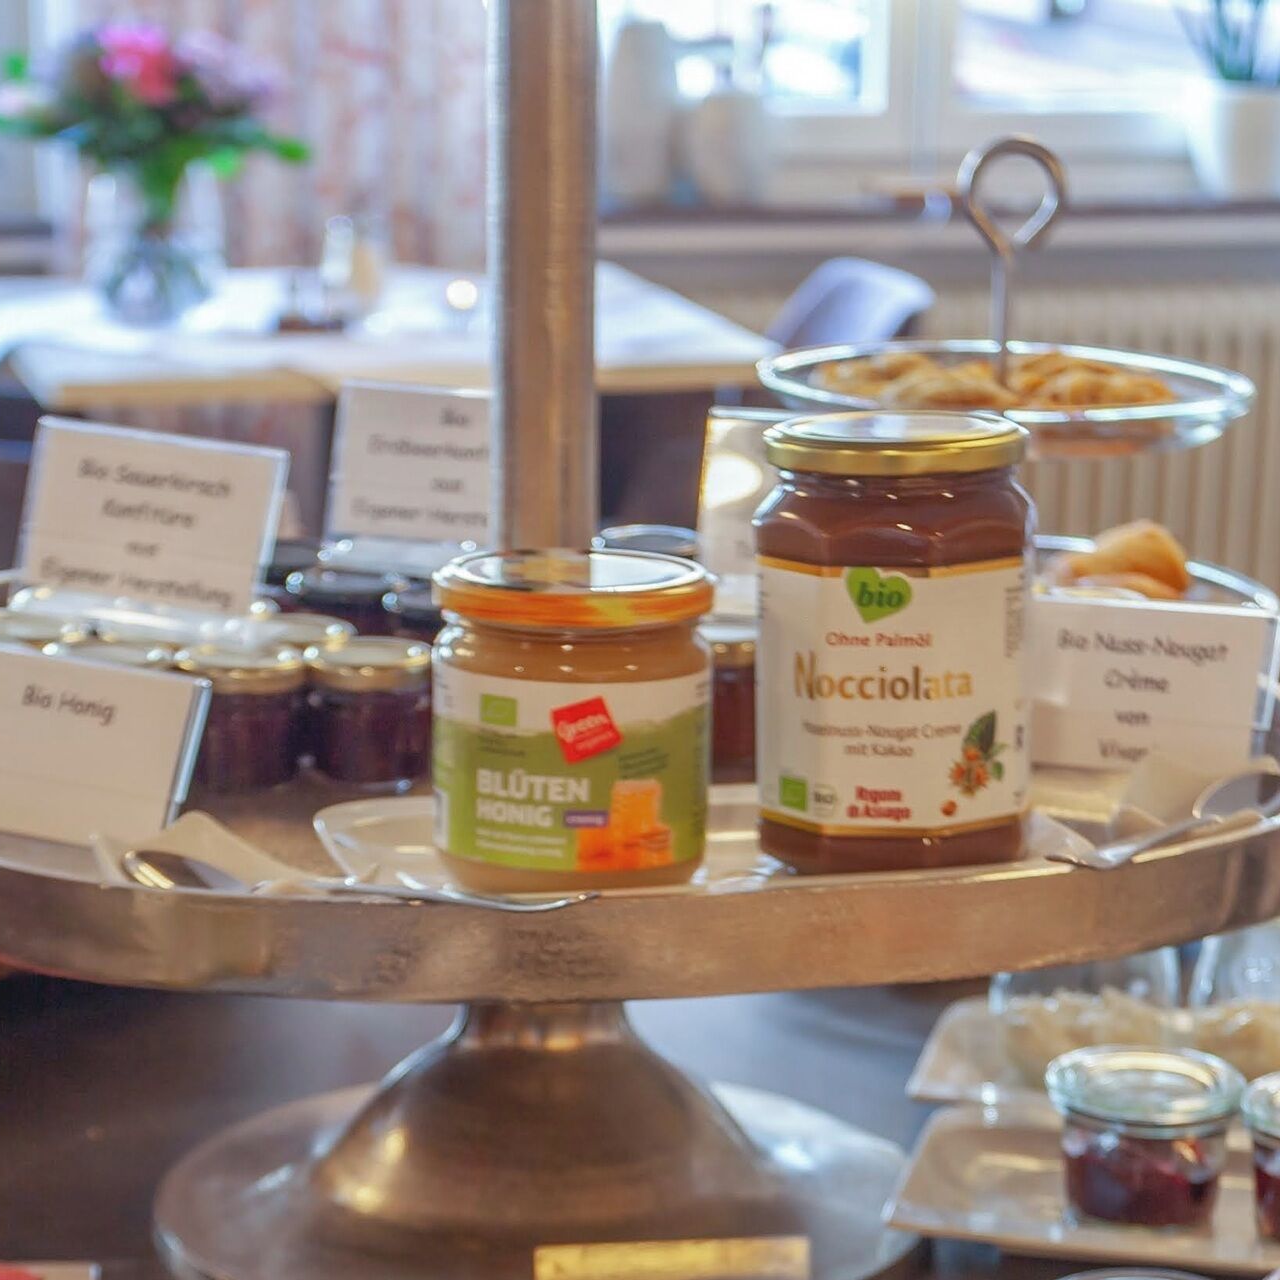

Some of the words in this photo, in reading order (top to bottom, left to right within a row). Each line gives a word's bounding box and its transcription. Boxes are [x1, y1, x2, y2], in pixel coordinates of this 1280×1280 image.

[857, 581, 904, 609] bio
[825, 631, 870, 647] Ohne
[876, 631, 932, 648] Palmöl
[1058, 630, 1090, 650] Bio
[794, 651, 974, 700] Nocciolata
[23, 685, 53, 708] Bio
[59, 689, 117, 727] Honig
[476, 768, 591, 803] BLÜTEN
[476, 798, 554, 828] HONIG
